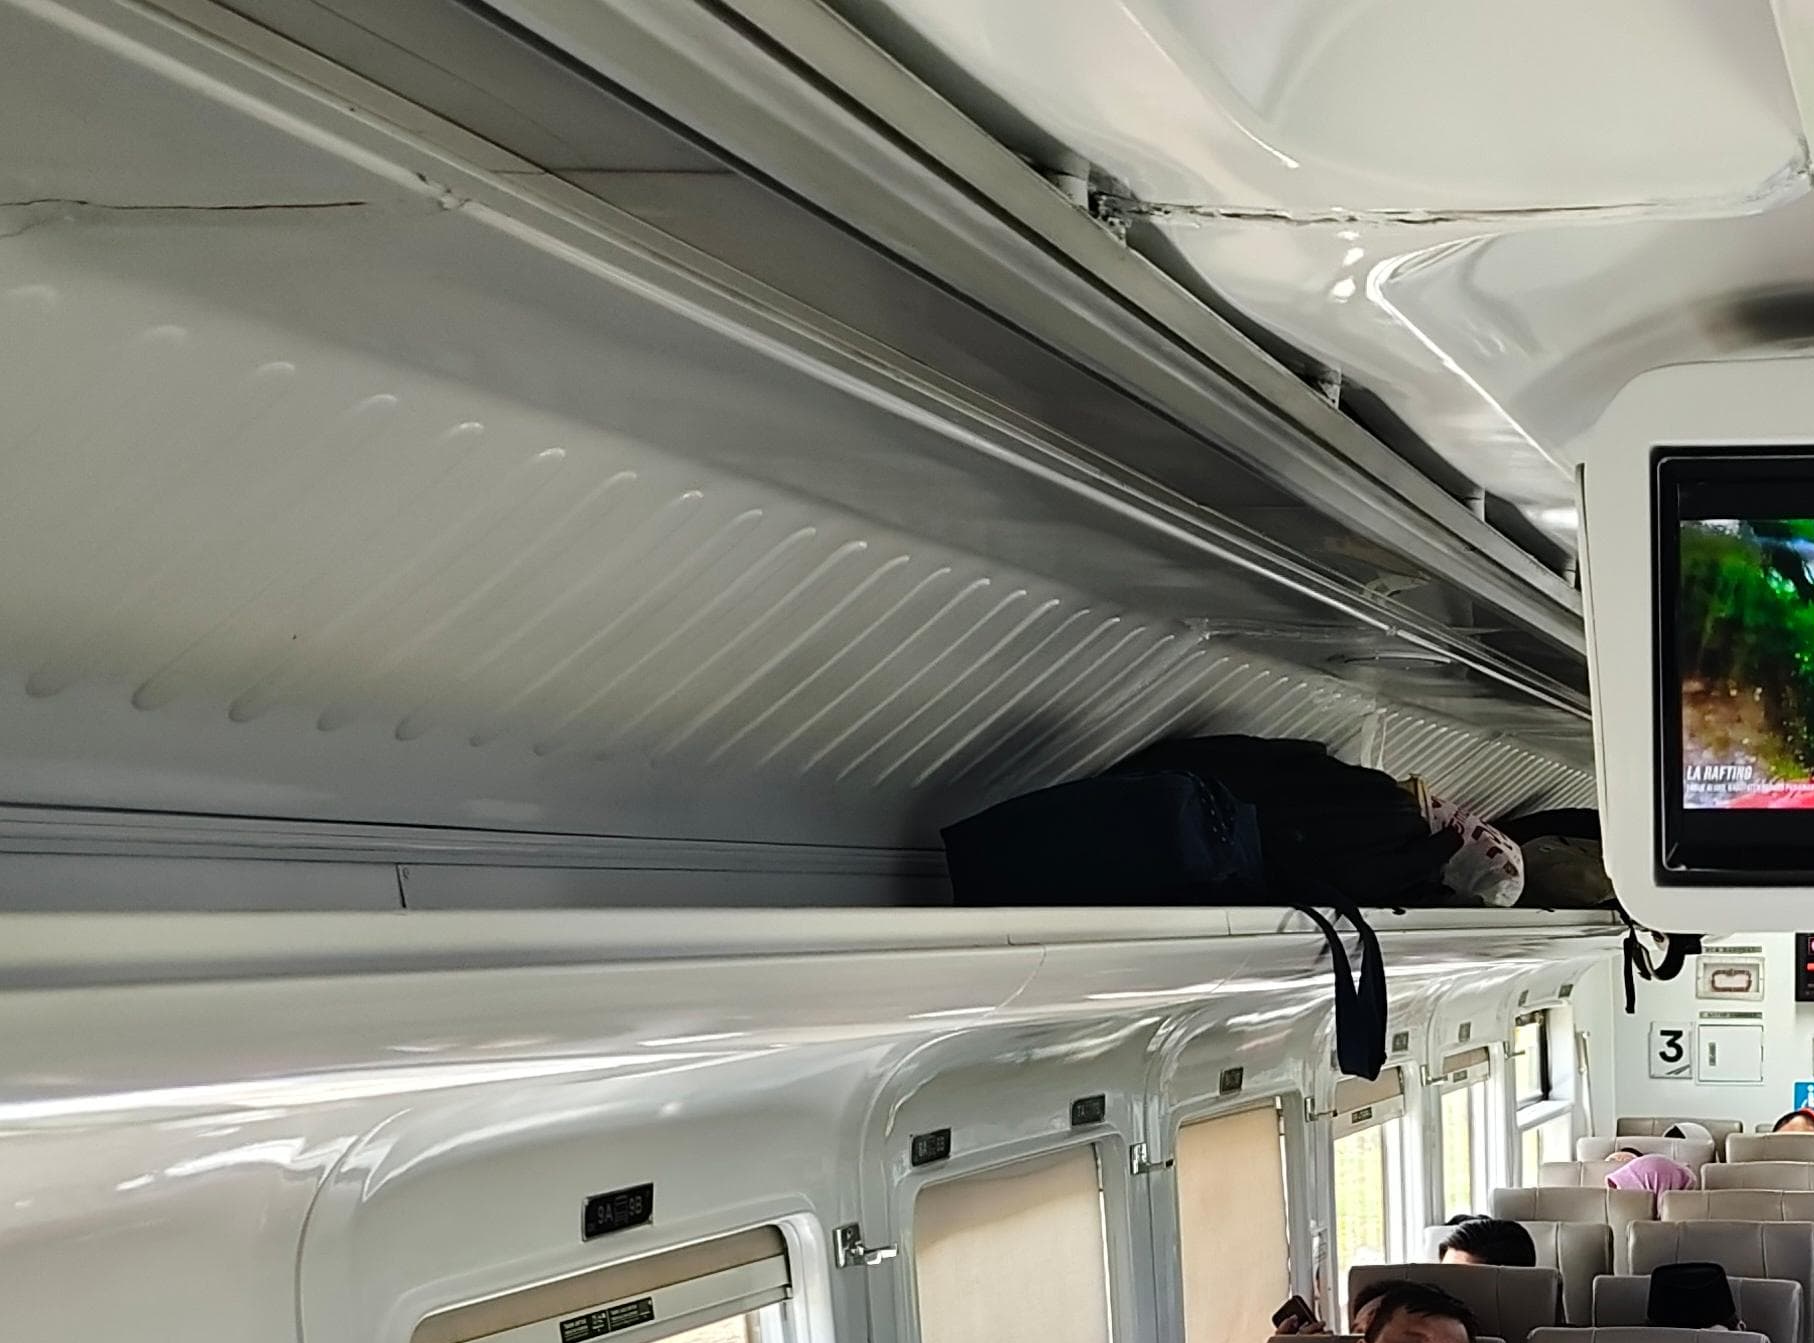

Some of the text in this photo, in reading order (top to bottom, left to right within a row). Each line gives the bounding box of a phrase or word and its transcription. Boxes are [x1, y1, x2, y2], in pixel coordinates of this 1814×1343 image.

[1659, 1030, 1684, 1063] 3
[597, 1196, 643, 1225] 9A 9B
